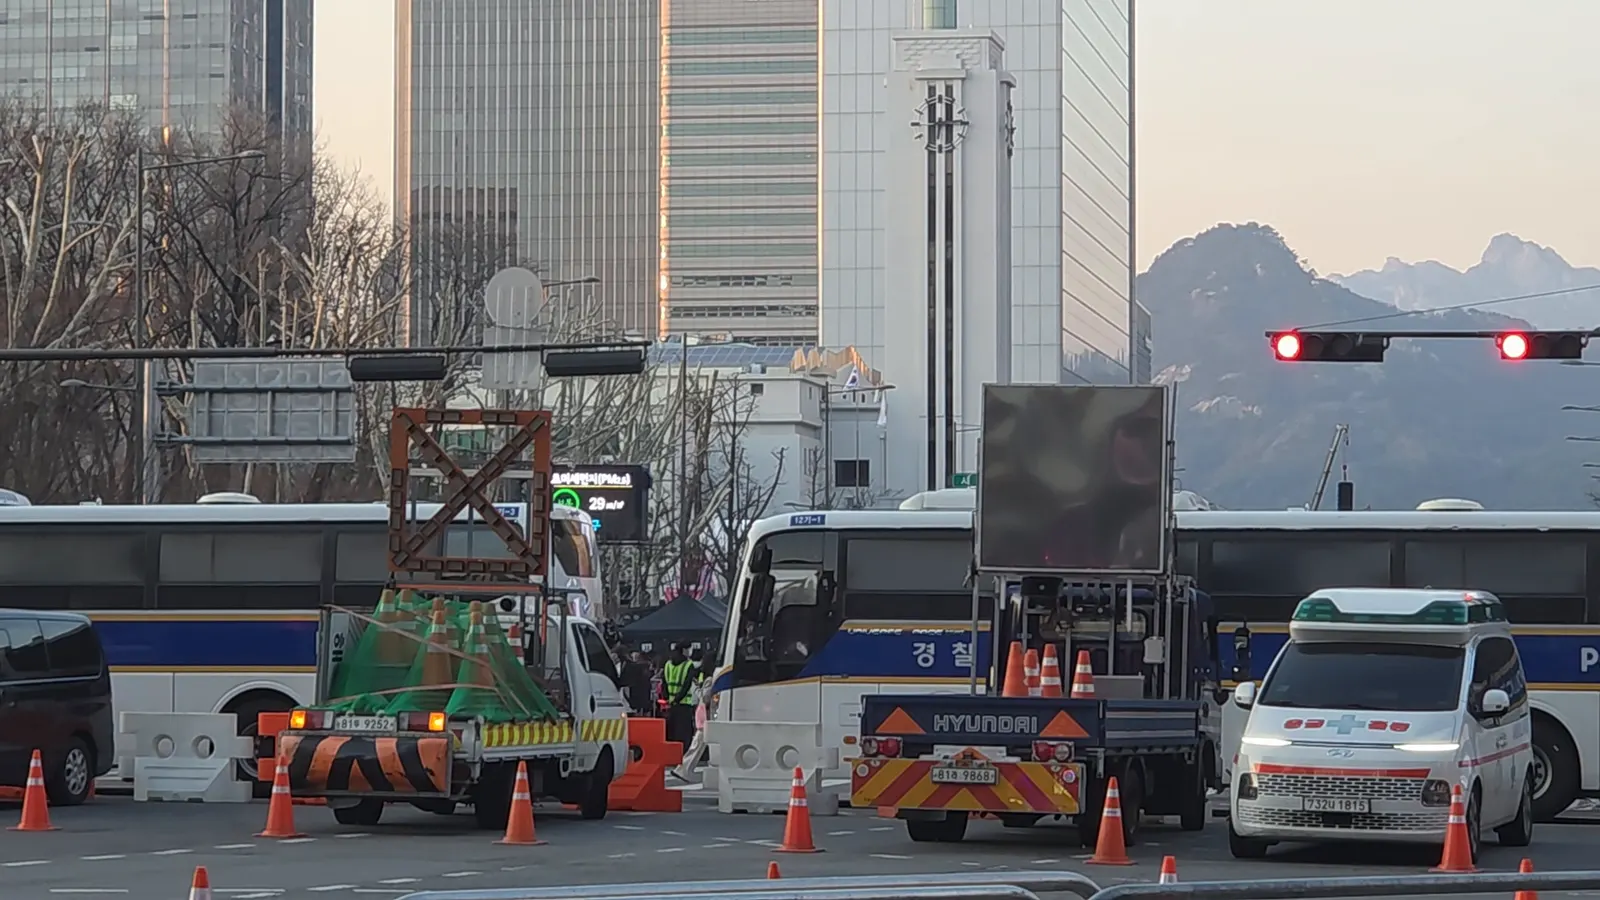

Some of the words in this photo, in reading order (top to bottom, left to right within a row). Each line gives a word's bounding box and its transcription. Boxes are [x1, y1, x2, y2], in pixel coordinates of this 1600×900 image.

[588, 496, 606, 511] 29
[794, 515, 821, 525] 12기-1
[1580, 646, 1600, 673] P
[364, 718, 390, 730] 9252
[933, 714, 1038, 734] HYUNDAI
[962, 770, 991, 782] 9868
[1338, 800, 1366, 812] 1815
